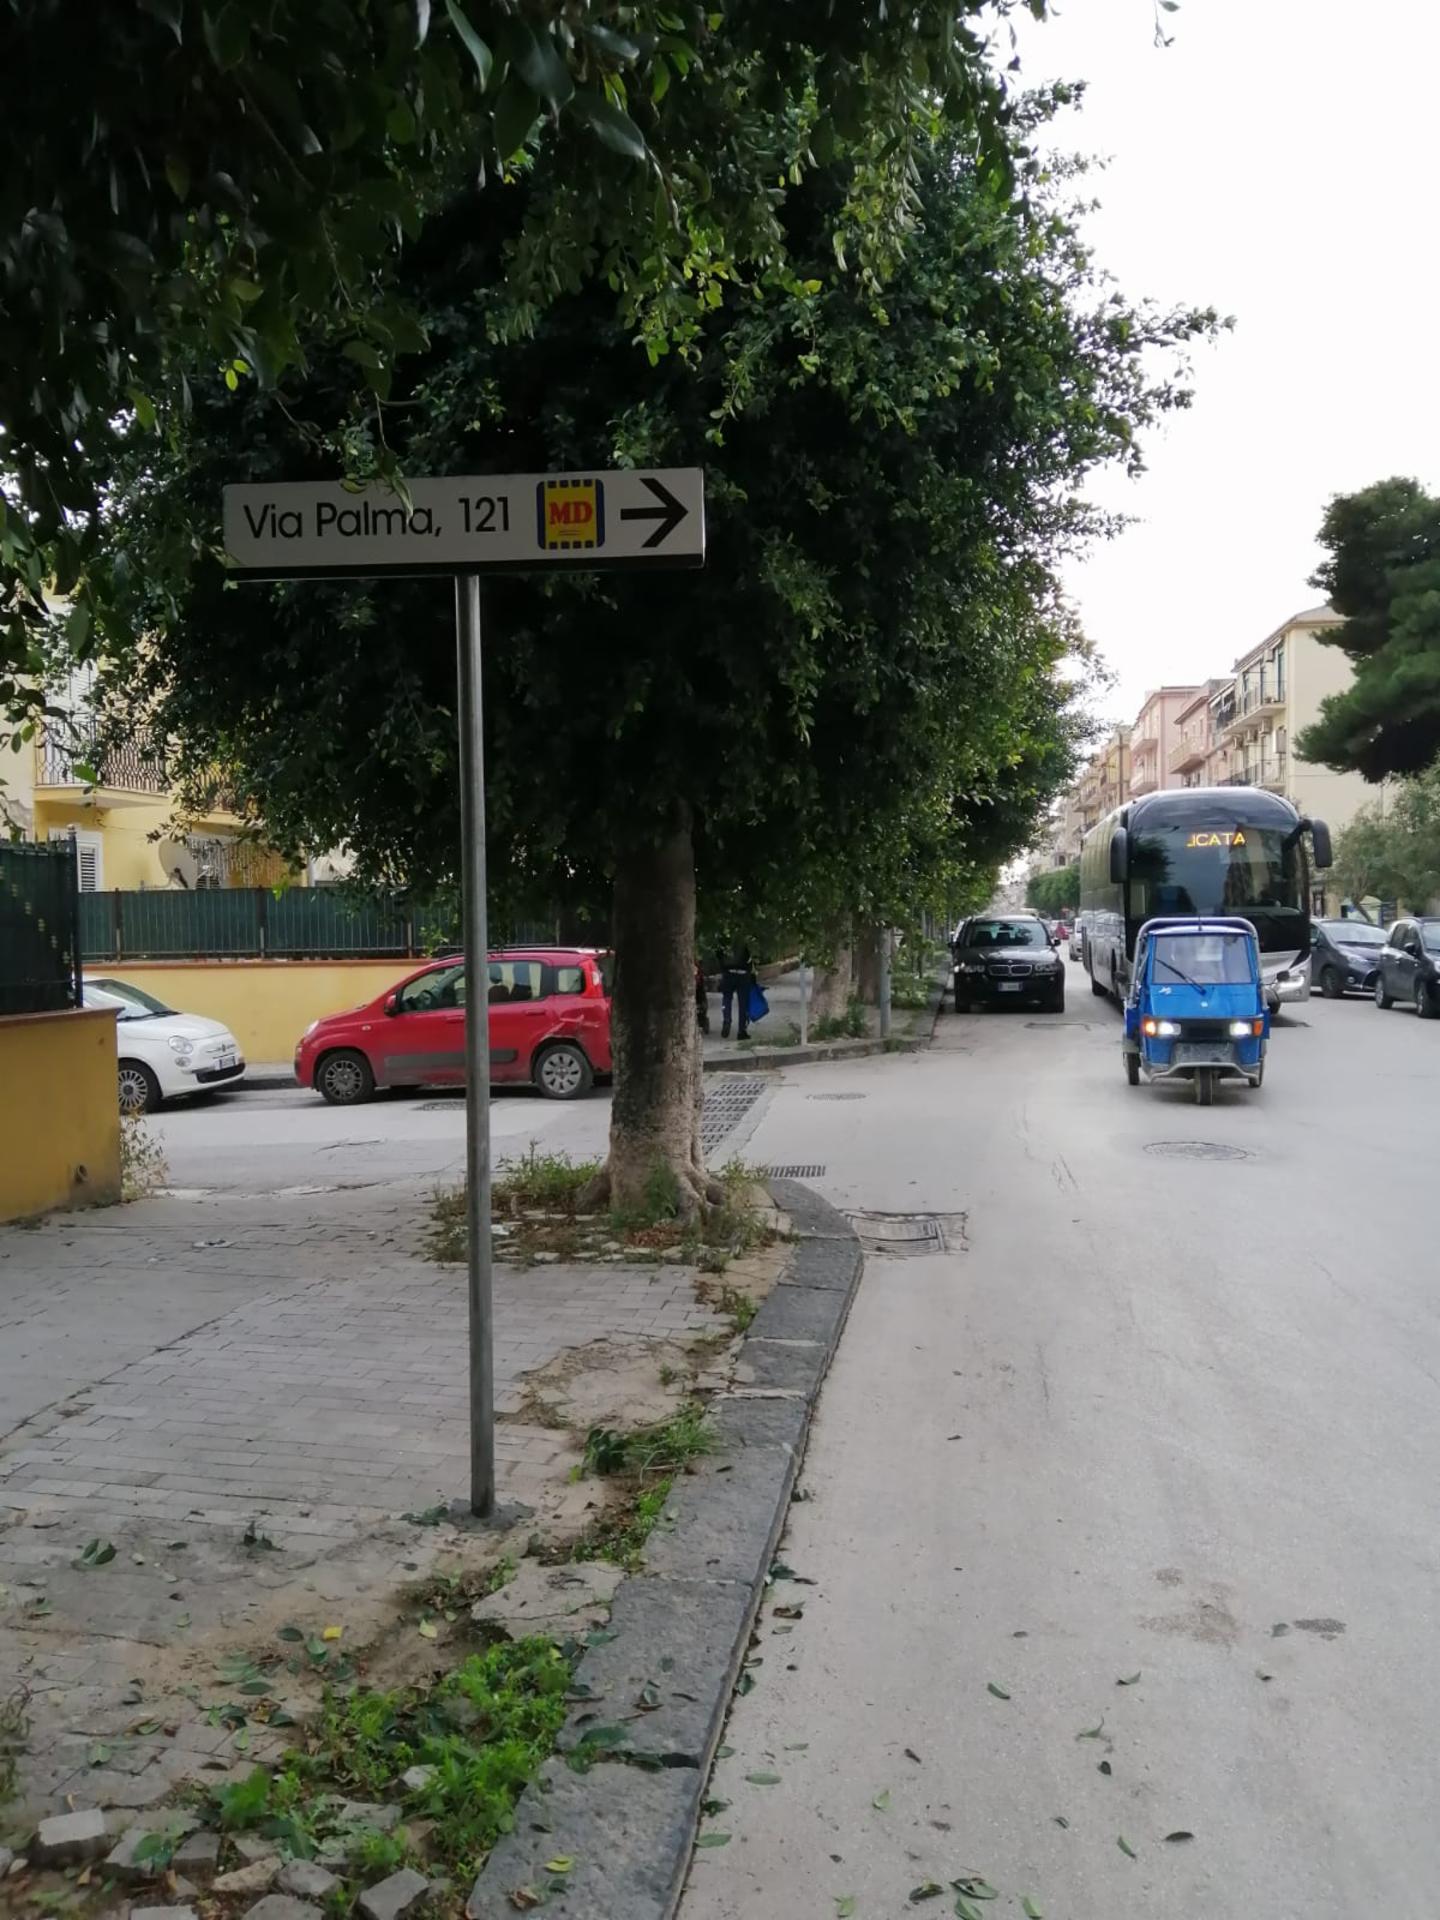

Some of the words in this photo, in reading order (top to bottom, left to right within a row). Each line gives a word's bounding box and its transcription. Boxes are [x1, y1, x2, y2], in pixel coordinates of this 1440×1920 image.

[243, 502, 303, 539] Via
[315, 499, 442, 538] Palma,
[457, 496, 510, 533] 121
[548, 500, 593, 525] MD
